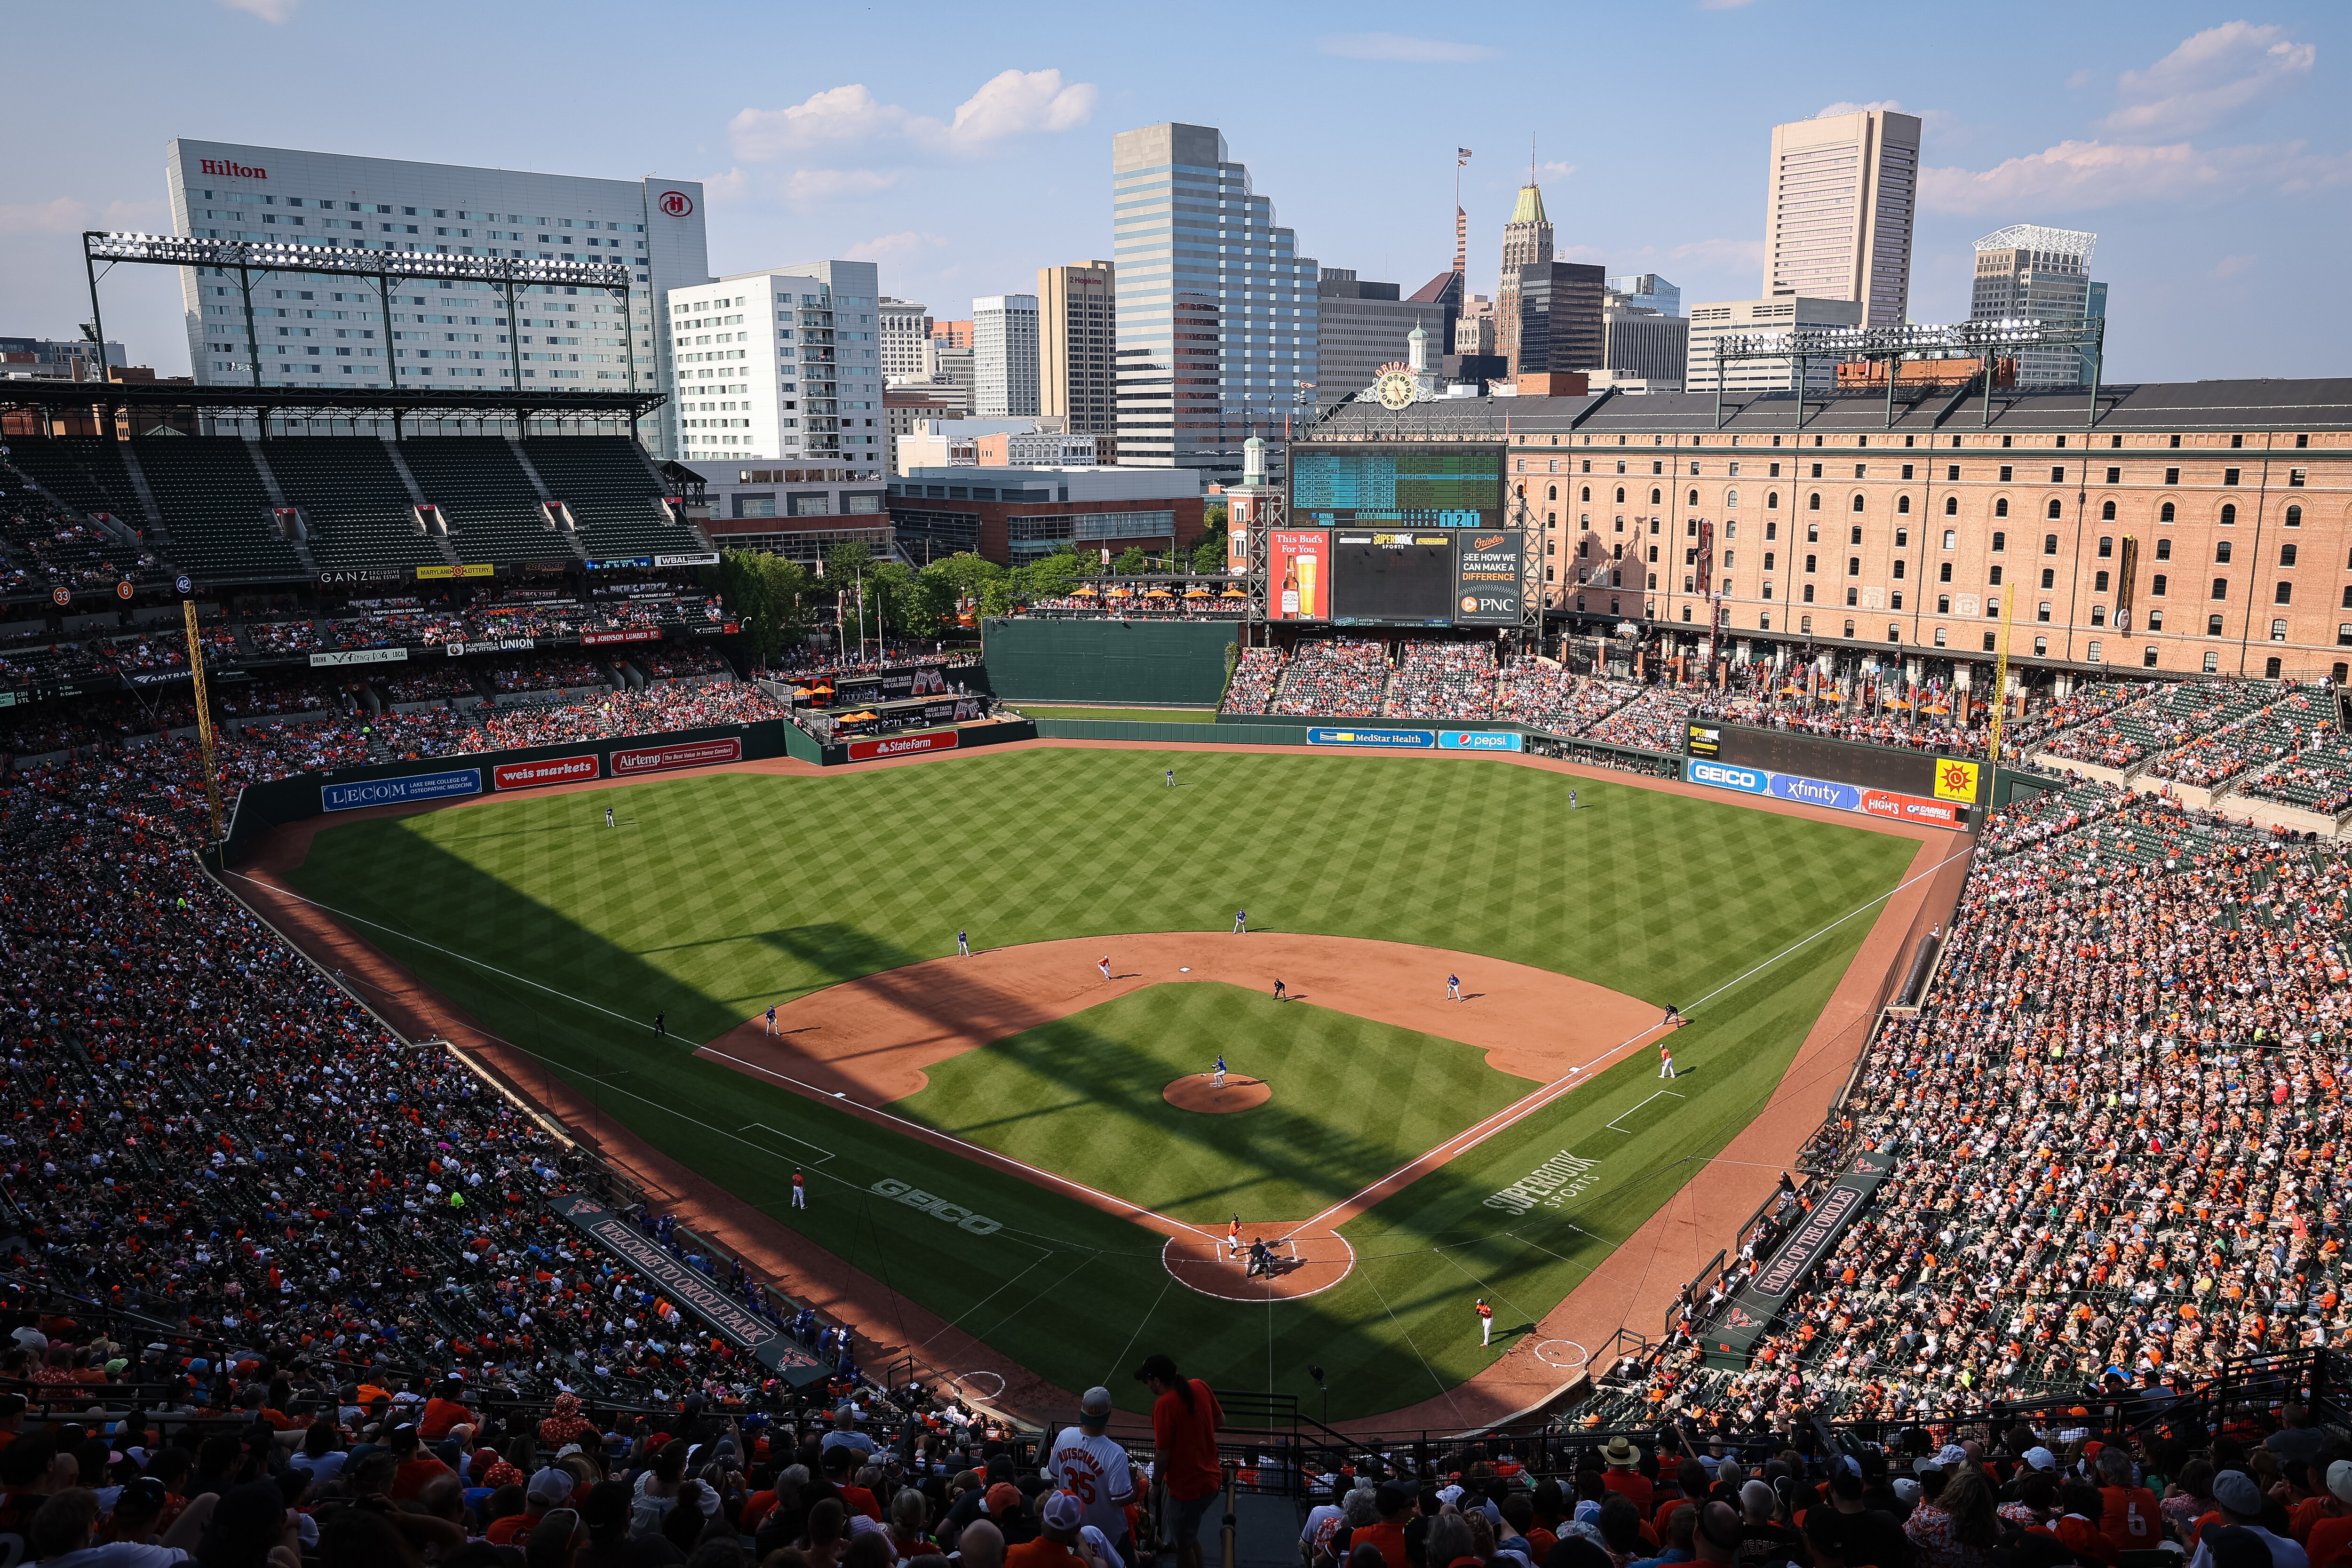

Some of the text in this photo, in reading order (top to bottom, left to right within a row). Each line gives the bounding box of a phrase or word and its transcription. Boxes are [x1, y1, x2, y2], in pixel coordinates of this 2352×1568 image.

[201, 159, 268, 179] Hilton
[1075, 276, 1102, 285] Hopkins
[1375, 361, 1418, 377] ORIOLES
[1456, 515, 1462, 526] 2
[1276, 534, 1323, 543] This Bud's
[1373, 533, 1414, 546] SUPERBOOK
[1474, 534, 1505, 551] Orioles
[1281, 545, 1317, 554] For You.
[1481, 553, 1501, 562] HOW
[1502, 553, 1516, 562] WE
[321, 571, 368, 583] GANZ
[122, 585, 129, 596] 8
[178, 580, 189, 589] 42
[56, 591, 68, 601] 33
[1479, 598, 1514, 612] PNC
[1334, 617, 1356, 626] Royals
[1617, 623, 1637, 635] BOOG'S
[501, 638, 534, 649] UNION
[373, 651, 388, 660] DOG
[151, 670, 194, 682] AMTRAK
[1356, 733, 1422, 743] MedStar Health
[1690, 726, 1720, 740] SUPERBOOK
[1474, 735, 1505, 747] pepsi
[620, 755, 660, 768] Airtemp
[502, 762, 591, 781] weis markets
[1695, 765, 1756, 788] GEICO
[410, 782, 473, 794] OSTEOPATHIC MEDICINE
[1788, 779, 1841, 804] xfinity
[1868, 798, 1899, 815] HIGH'S
[1920, 805, 1951, 817] CARROLL
[1483, 1149, 1602, 1216] SUPERBOOK
[1544, 1174, 1600, 1209] SPORTS
[871, 1178, 1003, 1235] GEICO
[1760, 1189, 1856, 1292] HOME OF THE ORIOLES
[597, 1222, 769, 1343] WELCOME TO ORIOLE PARK
[1058, 1447, 1105, 1478] RUTSCHMAN
[1064, 1465, 1096, 1505] 35
[2127, 1502, 2147, 1536] 6
